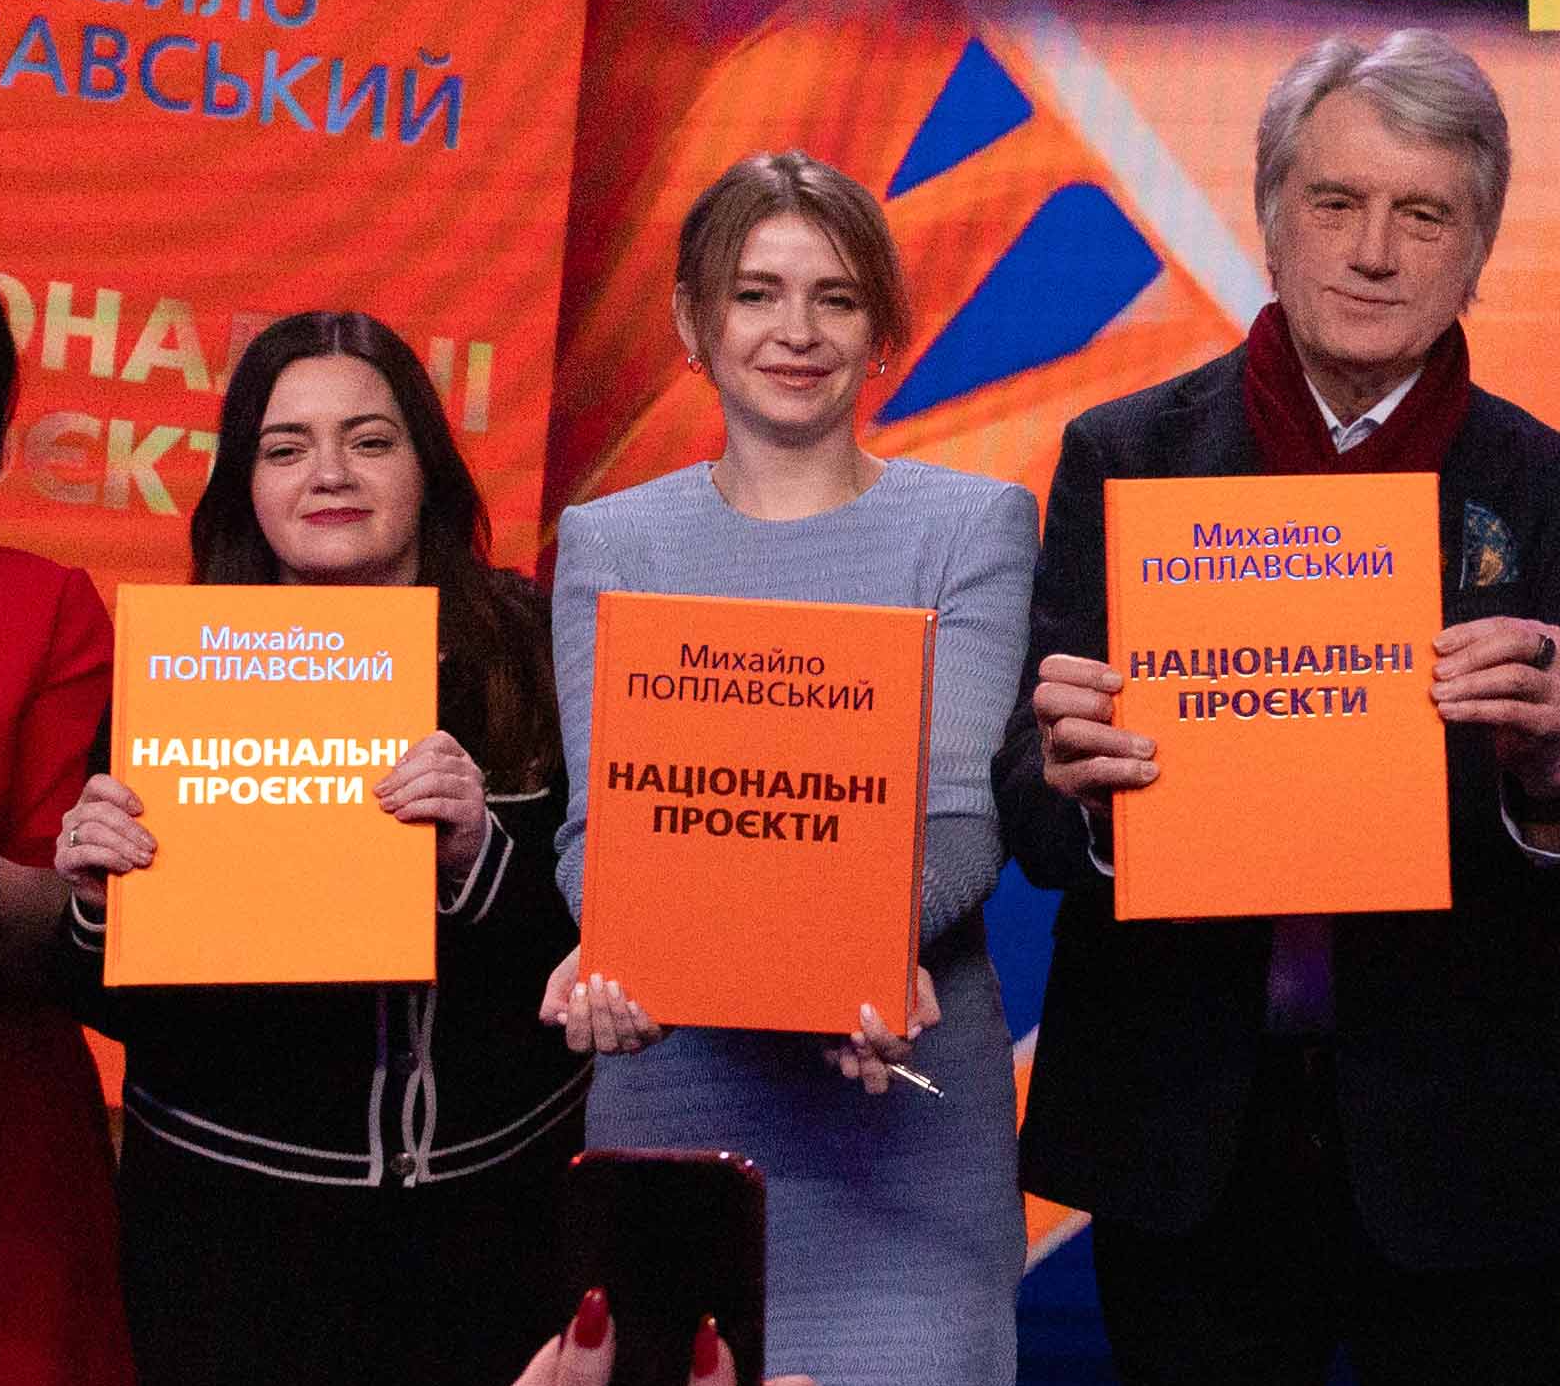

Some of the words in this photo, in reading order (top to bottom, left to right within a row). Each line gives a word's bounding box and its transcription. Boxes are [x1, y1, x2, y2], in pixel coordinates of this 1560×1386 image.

[1193, 520, 1342, 550] Михайло
[1142, 543, 1393, 585] ПОПЛАВСЬКИЙ
[200, 625, 345, 651] Михайло
[148, 650, 393, 682] ПОПЛАВСЬКИЙ
[680, 643, 825, 676] Михайло
[1130, 643, 1413, 684] НАЦІОНАЛЬНІ
[628, 672, 874, 711] ПОПЛАВСЬКИЙ
[1178, 686, 1368, 721] ПРОЄКТИ
[131, 737, 409, 770] НАЦІОНАЛЬНІ
[178, 776, 364, 805] ПРОЄКТИ
[607, 761, 887, 804] НАЦІОНАЛЬНІ
[653, 805, 839, 843] ПРОЄКТИ
